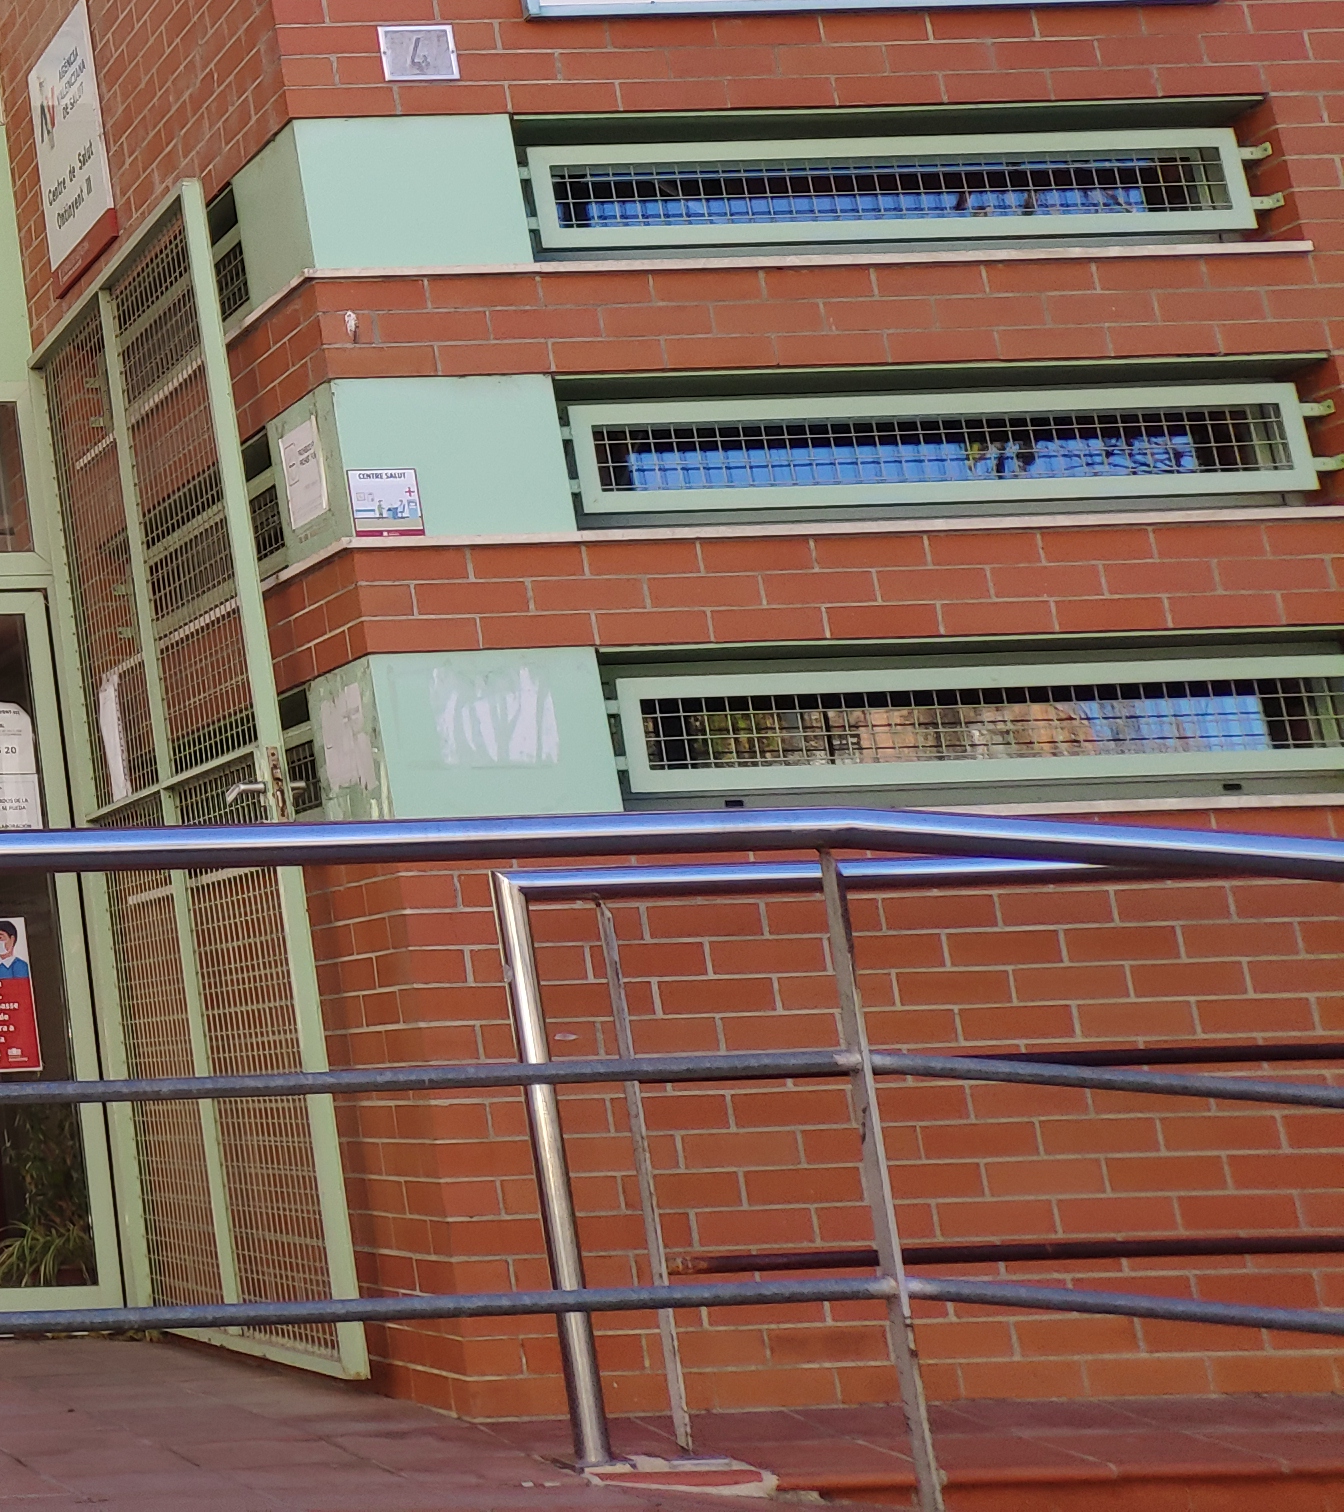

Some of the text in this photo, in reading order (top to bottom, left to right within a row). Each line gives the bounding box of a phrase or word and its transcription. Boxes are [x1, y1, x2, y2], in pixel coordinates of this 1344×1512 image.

[62, 102, 70, 120] DE
[48, 139, 94, 206] Centre de Salut
[57, 186, 84, 230] Ontinyent
[358, 472, 406, 480] CENTRE SALUT
[4, 746, 17, 754] 20
